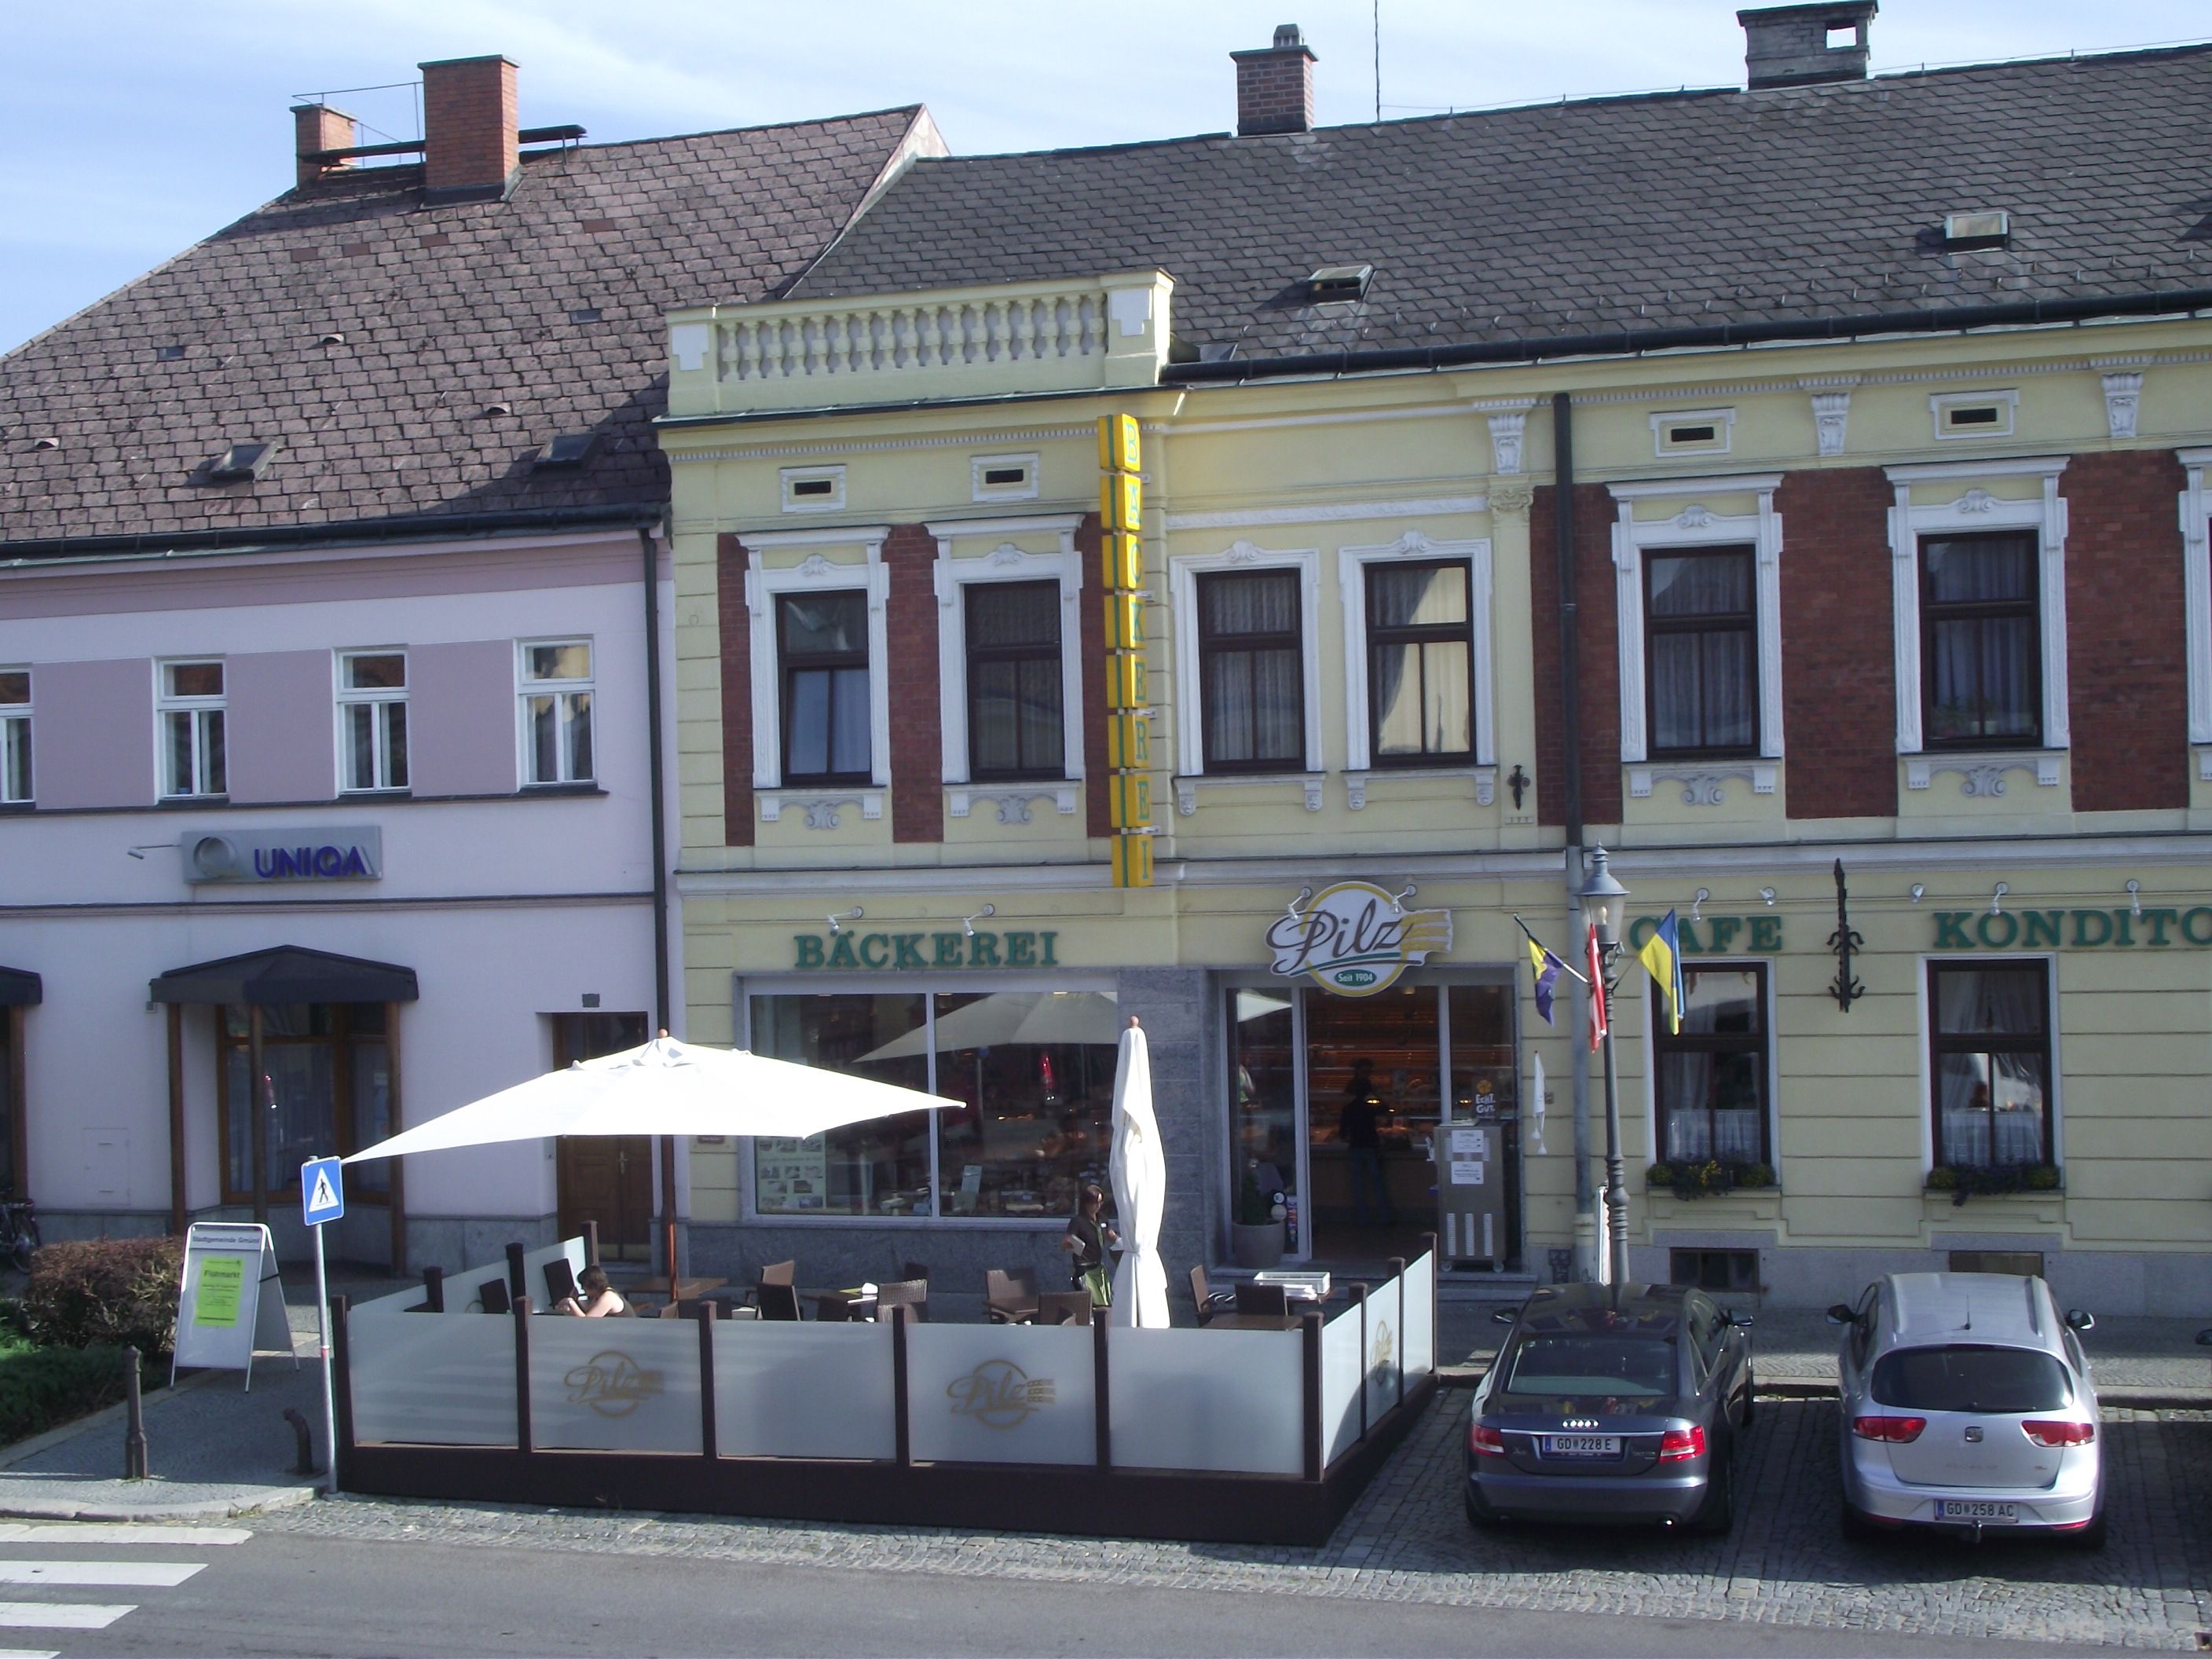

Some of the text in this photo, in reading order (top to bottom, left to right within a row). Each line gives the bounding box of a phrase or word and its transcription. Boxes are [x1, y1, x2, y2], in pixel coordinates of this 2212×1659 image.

[254, 845, 368, 878] UNIQA
[793, 930, 1058, 968] BÄCKEREI
[1265, 898, 1414, 973] Pilz
[1629, 916, 1782, 953] CAFE
[1338, 972, 1373, 982] Seit 1904
[1557, 1438, 1612, 1451] GD 228 E
[1946, 1503, 2014, 1517] GD 258 AC
